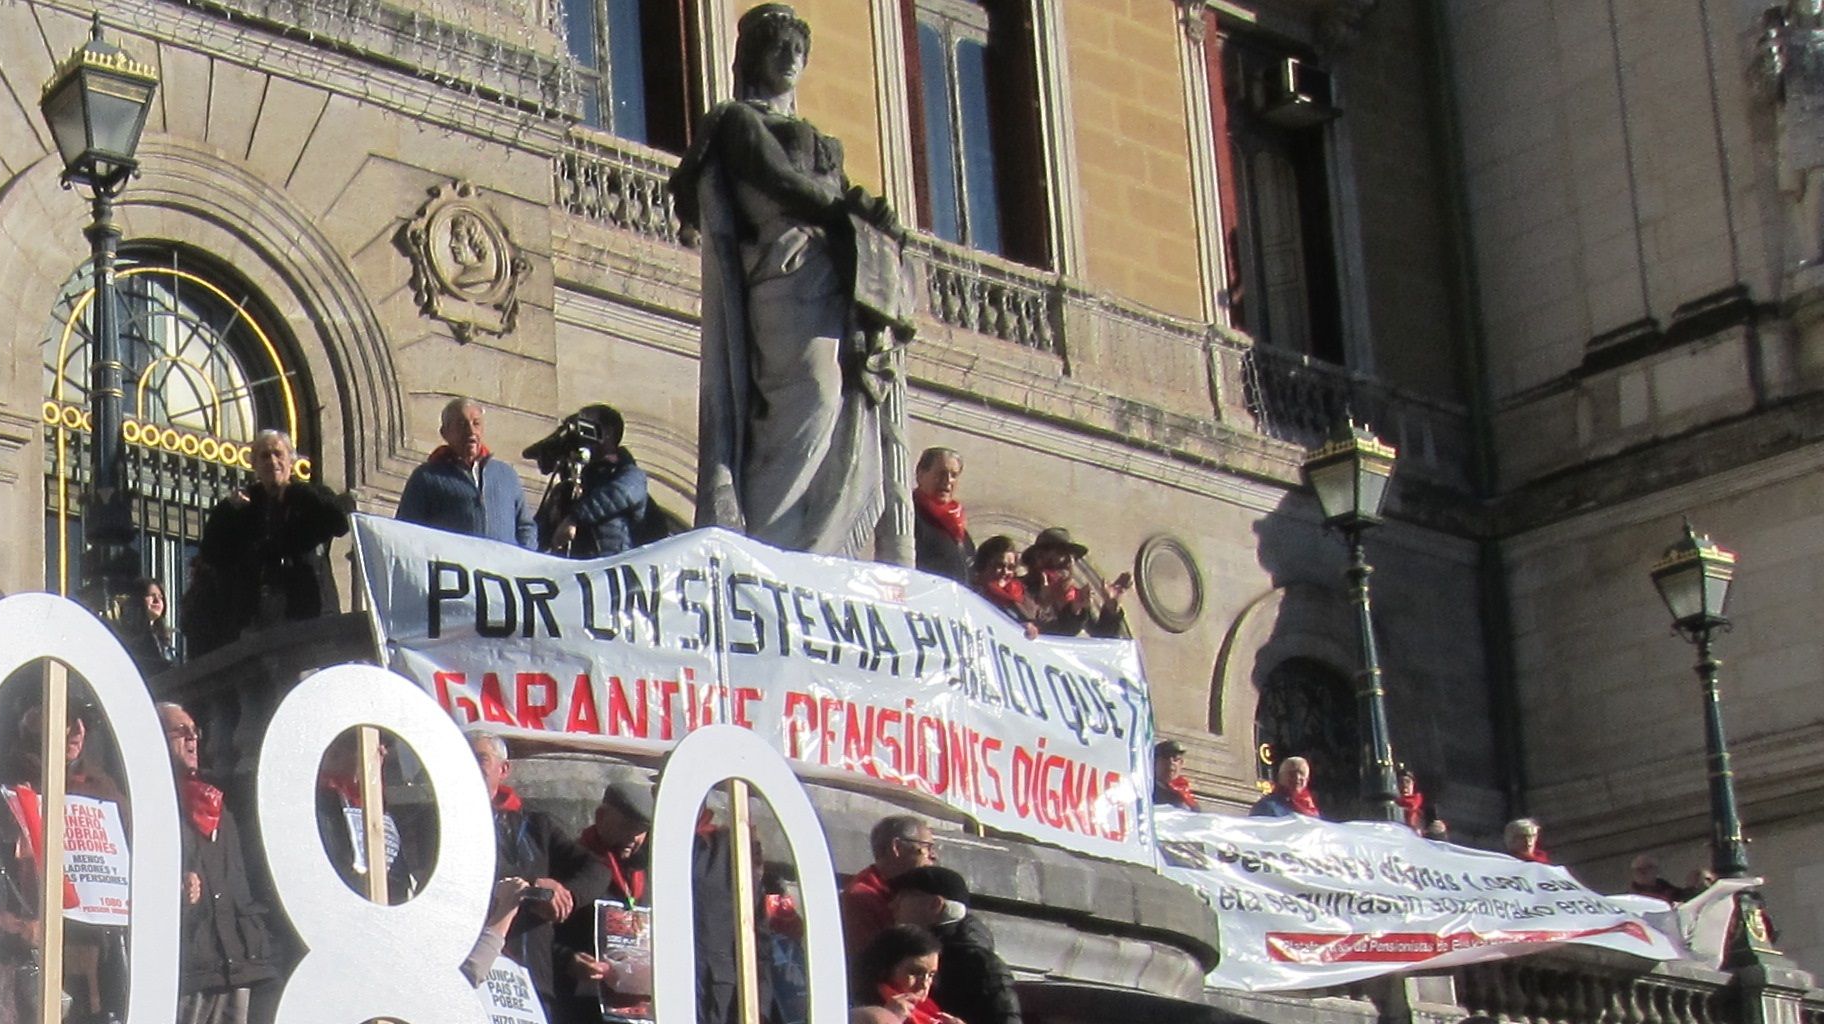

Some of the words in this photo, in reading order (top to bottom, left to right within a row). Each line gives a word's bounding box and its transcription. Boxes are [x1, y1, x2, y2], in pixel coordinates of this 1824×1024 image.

[427, 559, 563, 639] POR
[576, 563, 662, 650] UN
[1043, 664, 1125, 746] QUE
[71, 804, 106, 820] FALTA
[64, 827, 108, 841] OBRAN
[72, 854, 105, 865] MENOS
[79, 873, 128, 886] PENSIONES
[1379, 854, 1461, 892] dignas
